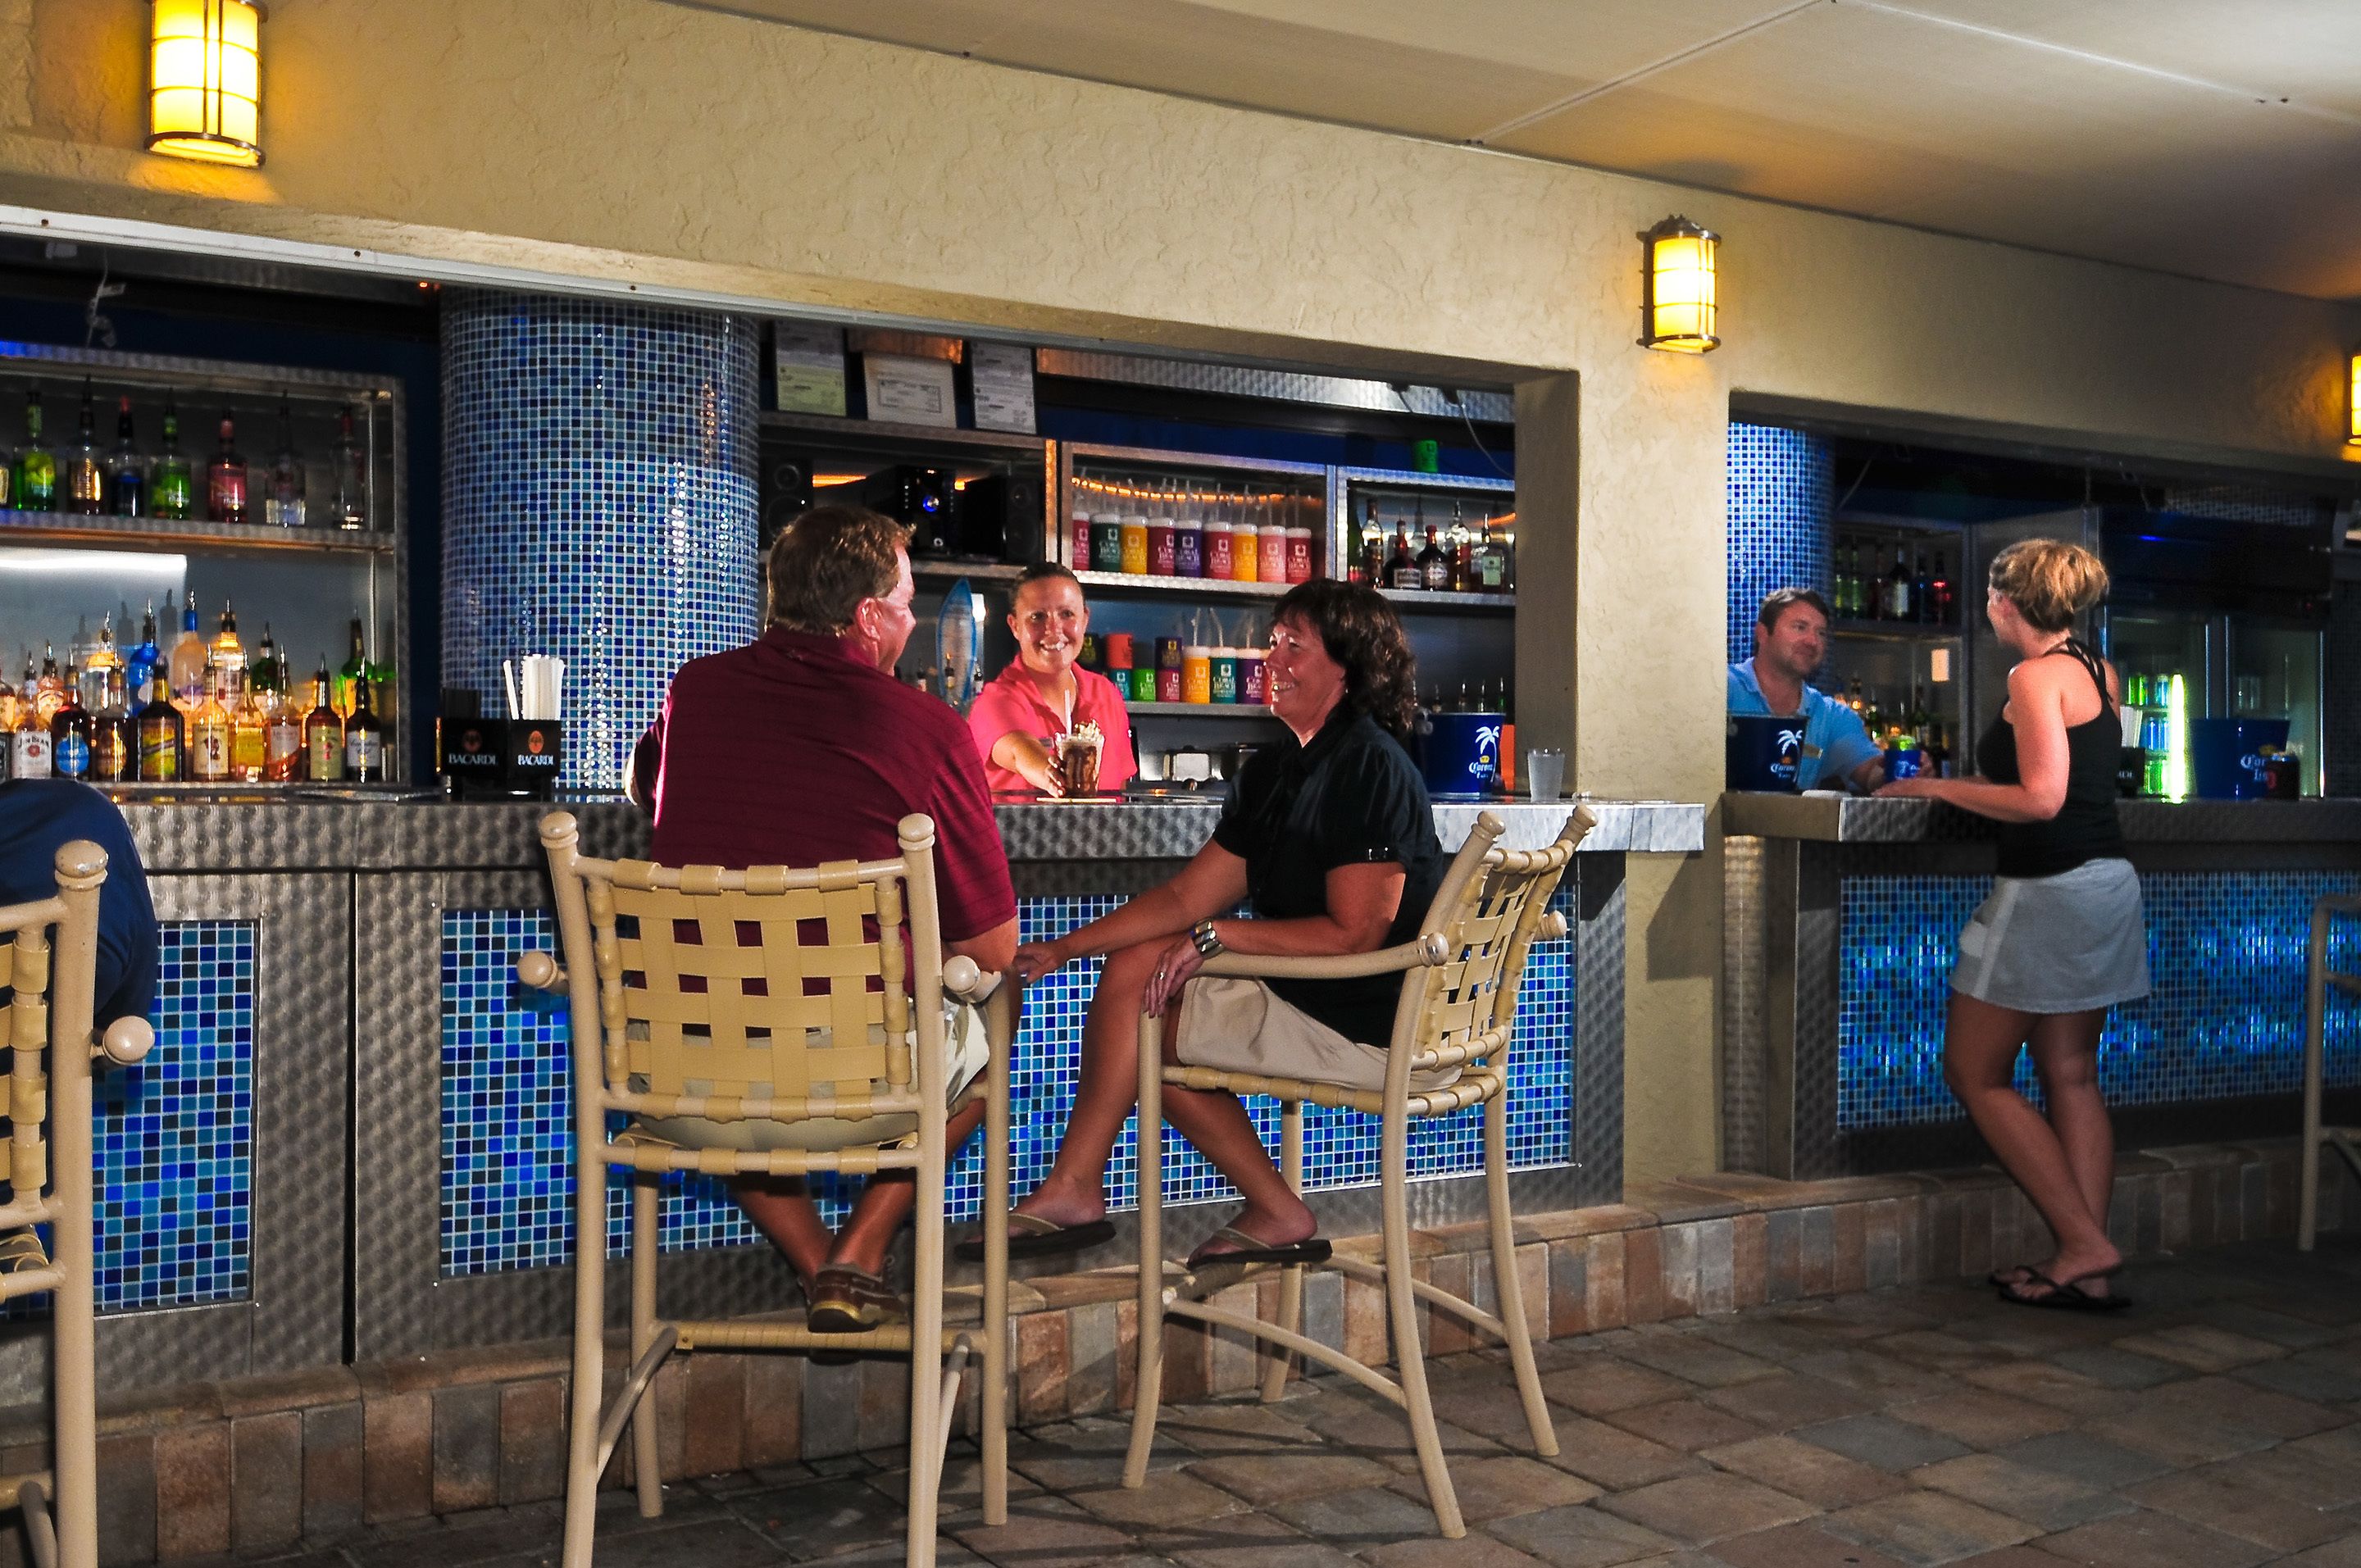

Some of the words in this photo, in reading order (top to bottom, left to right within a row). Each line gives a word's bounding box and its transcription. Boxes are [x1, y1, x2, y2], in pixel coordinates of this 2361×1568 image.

[448, 754, 497, 765] BACARDI
[517, 754, 554, 766] BACARDI
[2240, 754, 2266, 770] Cor
